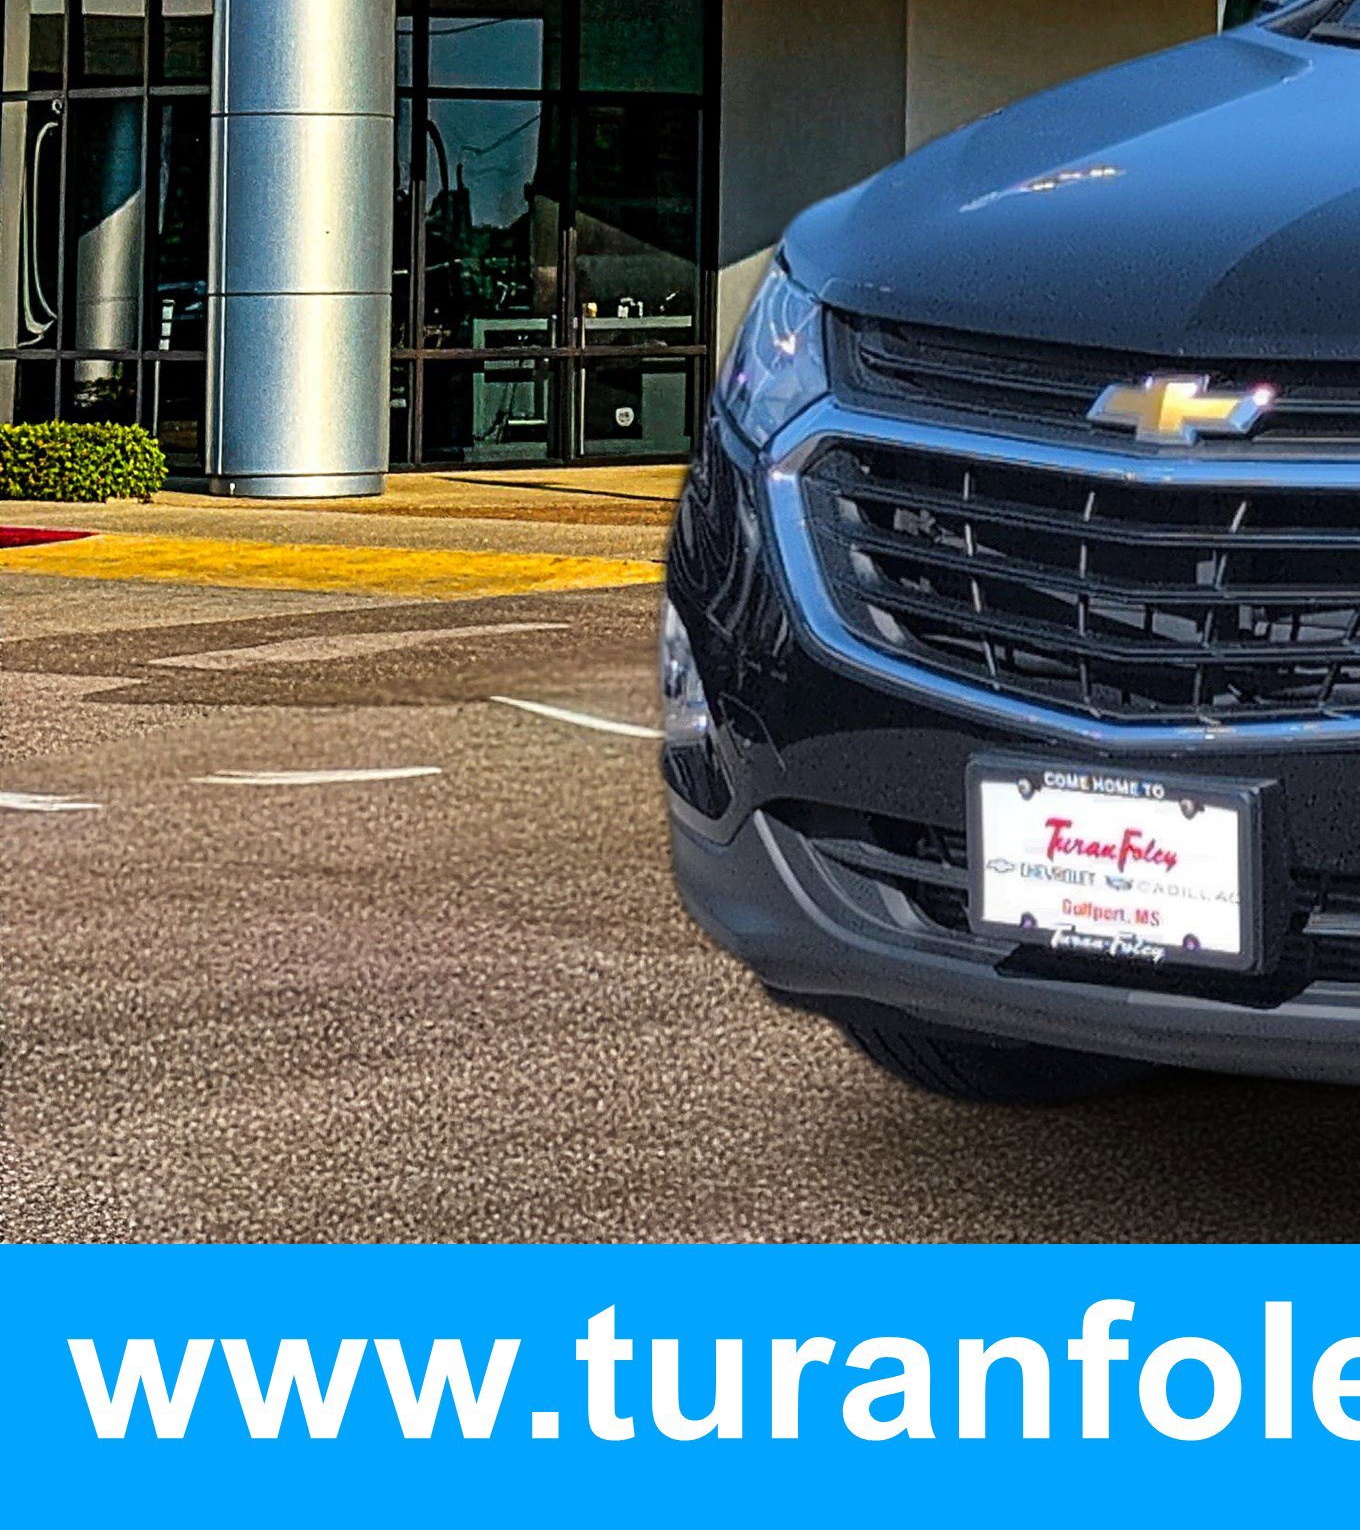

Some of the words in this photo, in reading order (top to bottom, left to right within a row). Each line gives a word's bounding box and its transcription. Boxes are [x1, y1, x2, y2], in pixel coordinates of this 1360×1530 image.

[1043, 770, 1090, 790] COME
[1093, 775, 1139, 795] HOME
[1140, 781, 1165, 799] TO
[1044, 817, 1117, 862] Turan
[1117, 828, 1178, 873] Foley
[1135, 907, 1161, 927] MS
